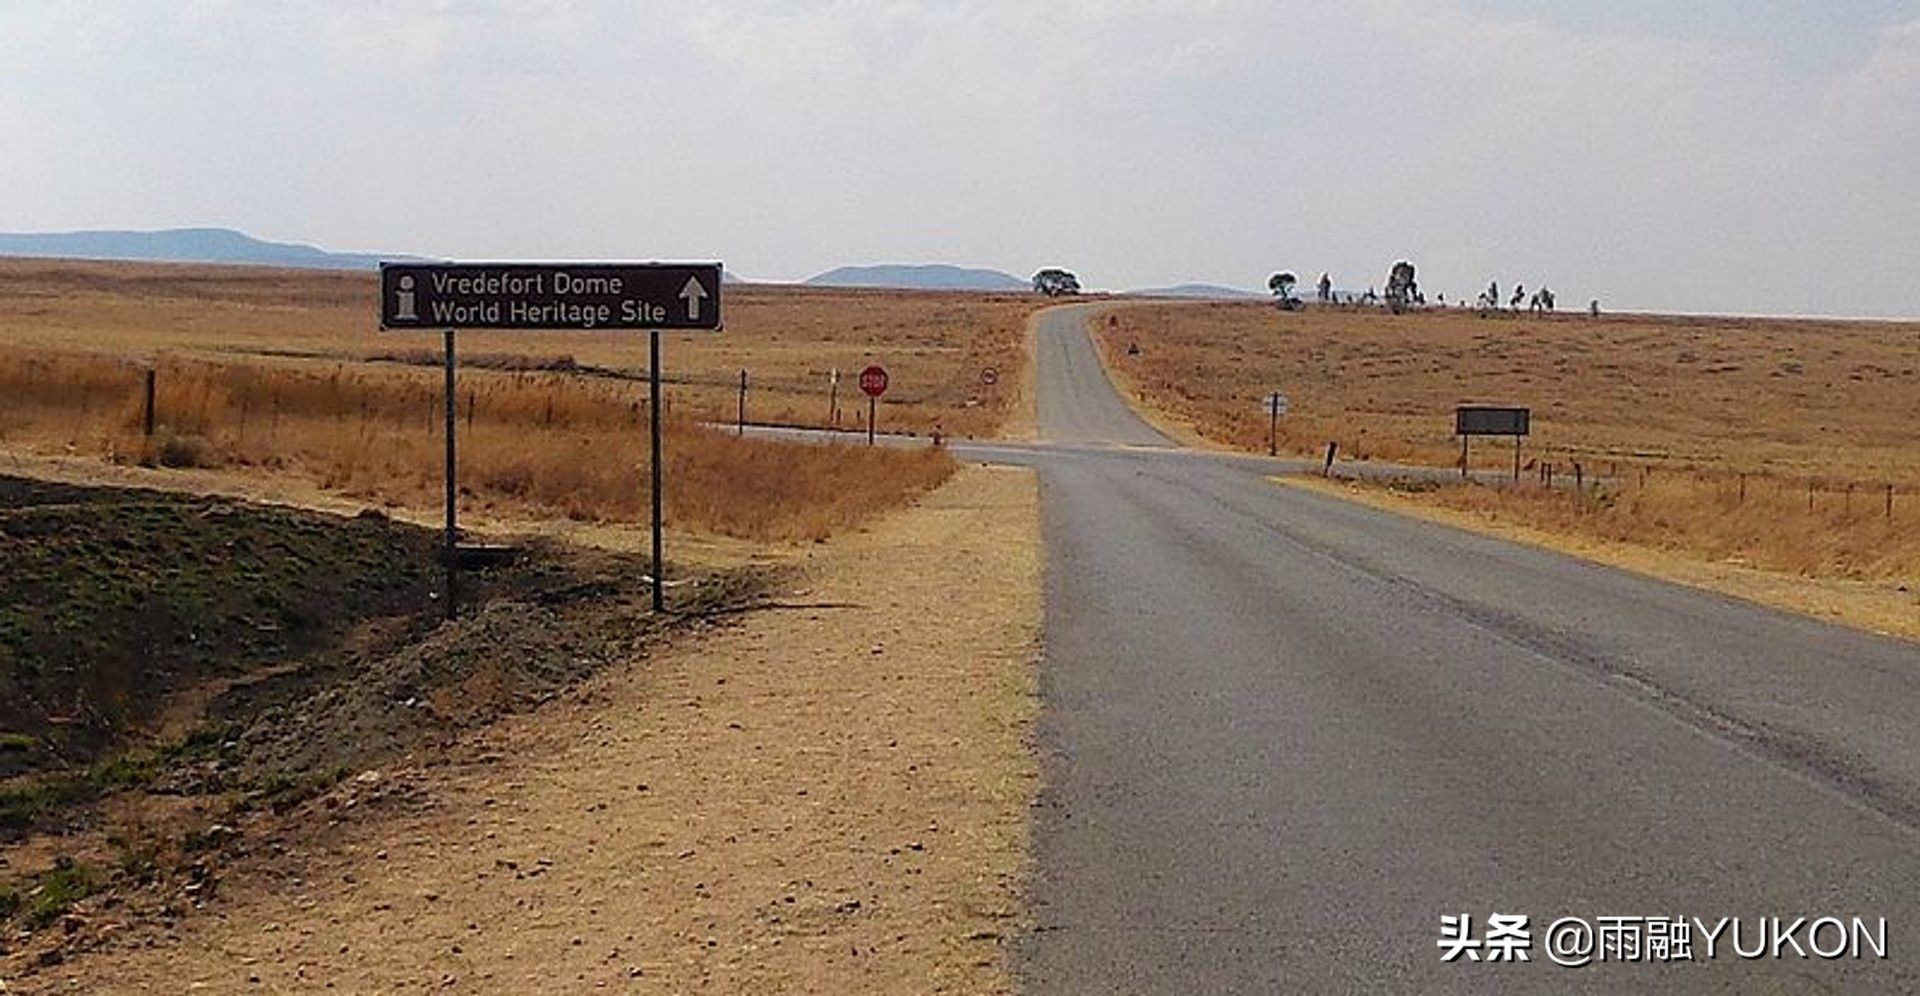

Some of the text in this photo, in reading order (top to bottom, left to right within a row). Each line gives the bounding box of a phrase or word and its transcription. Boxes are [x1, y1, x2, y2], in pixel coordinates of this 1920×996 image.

[431, 272, 623, 295] Vredefort Dome
[431, 300, 666, 328] World Heritage Site
